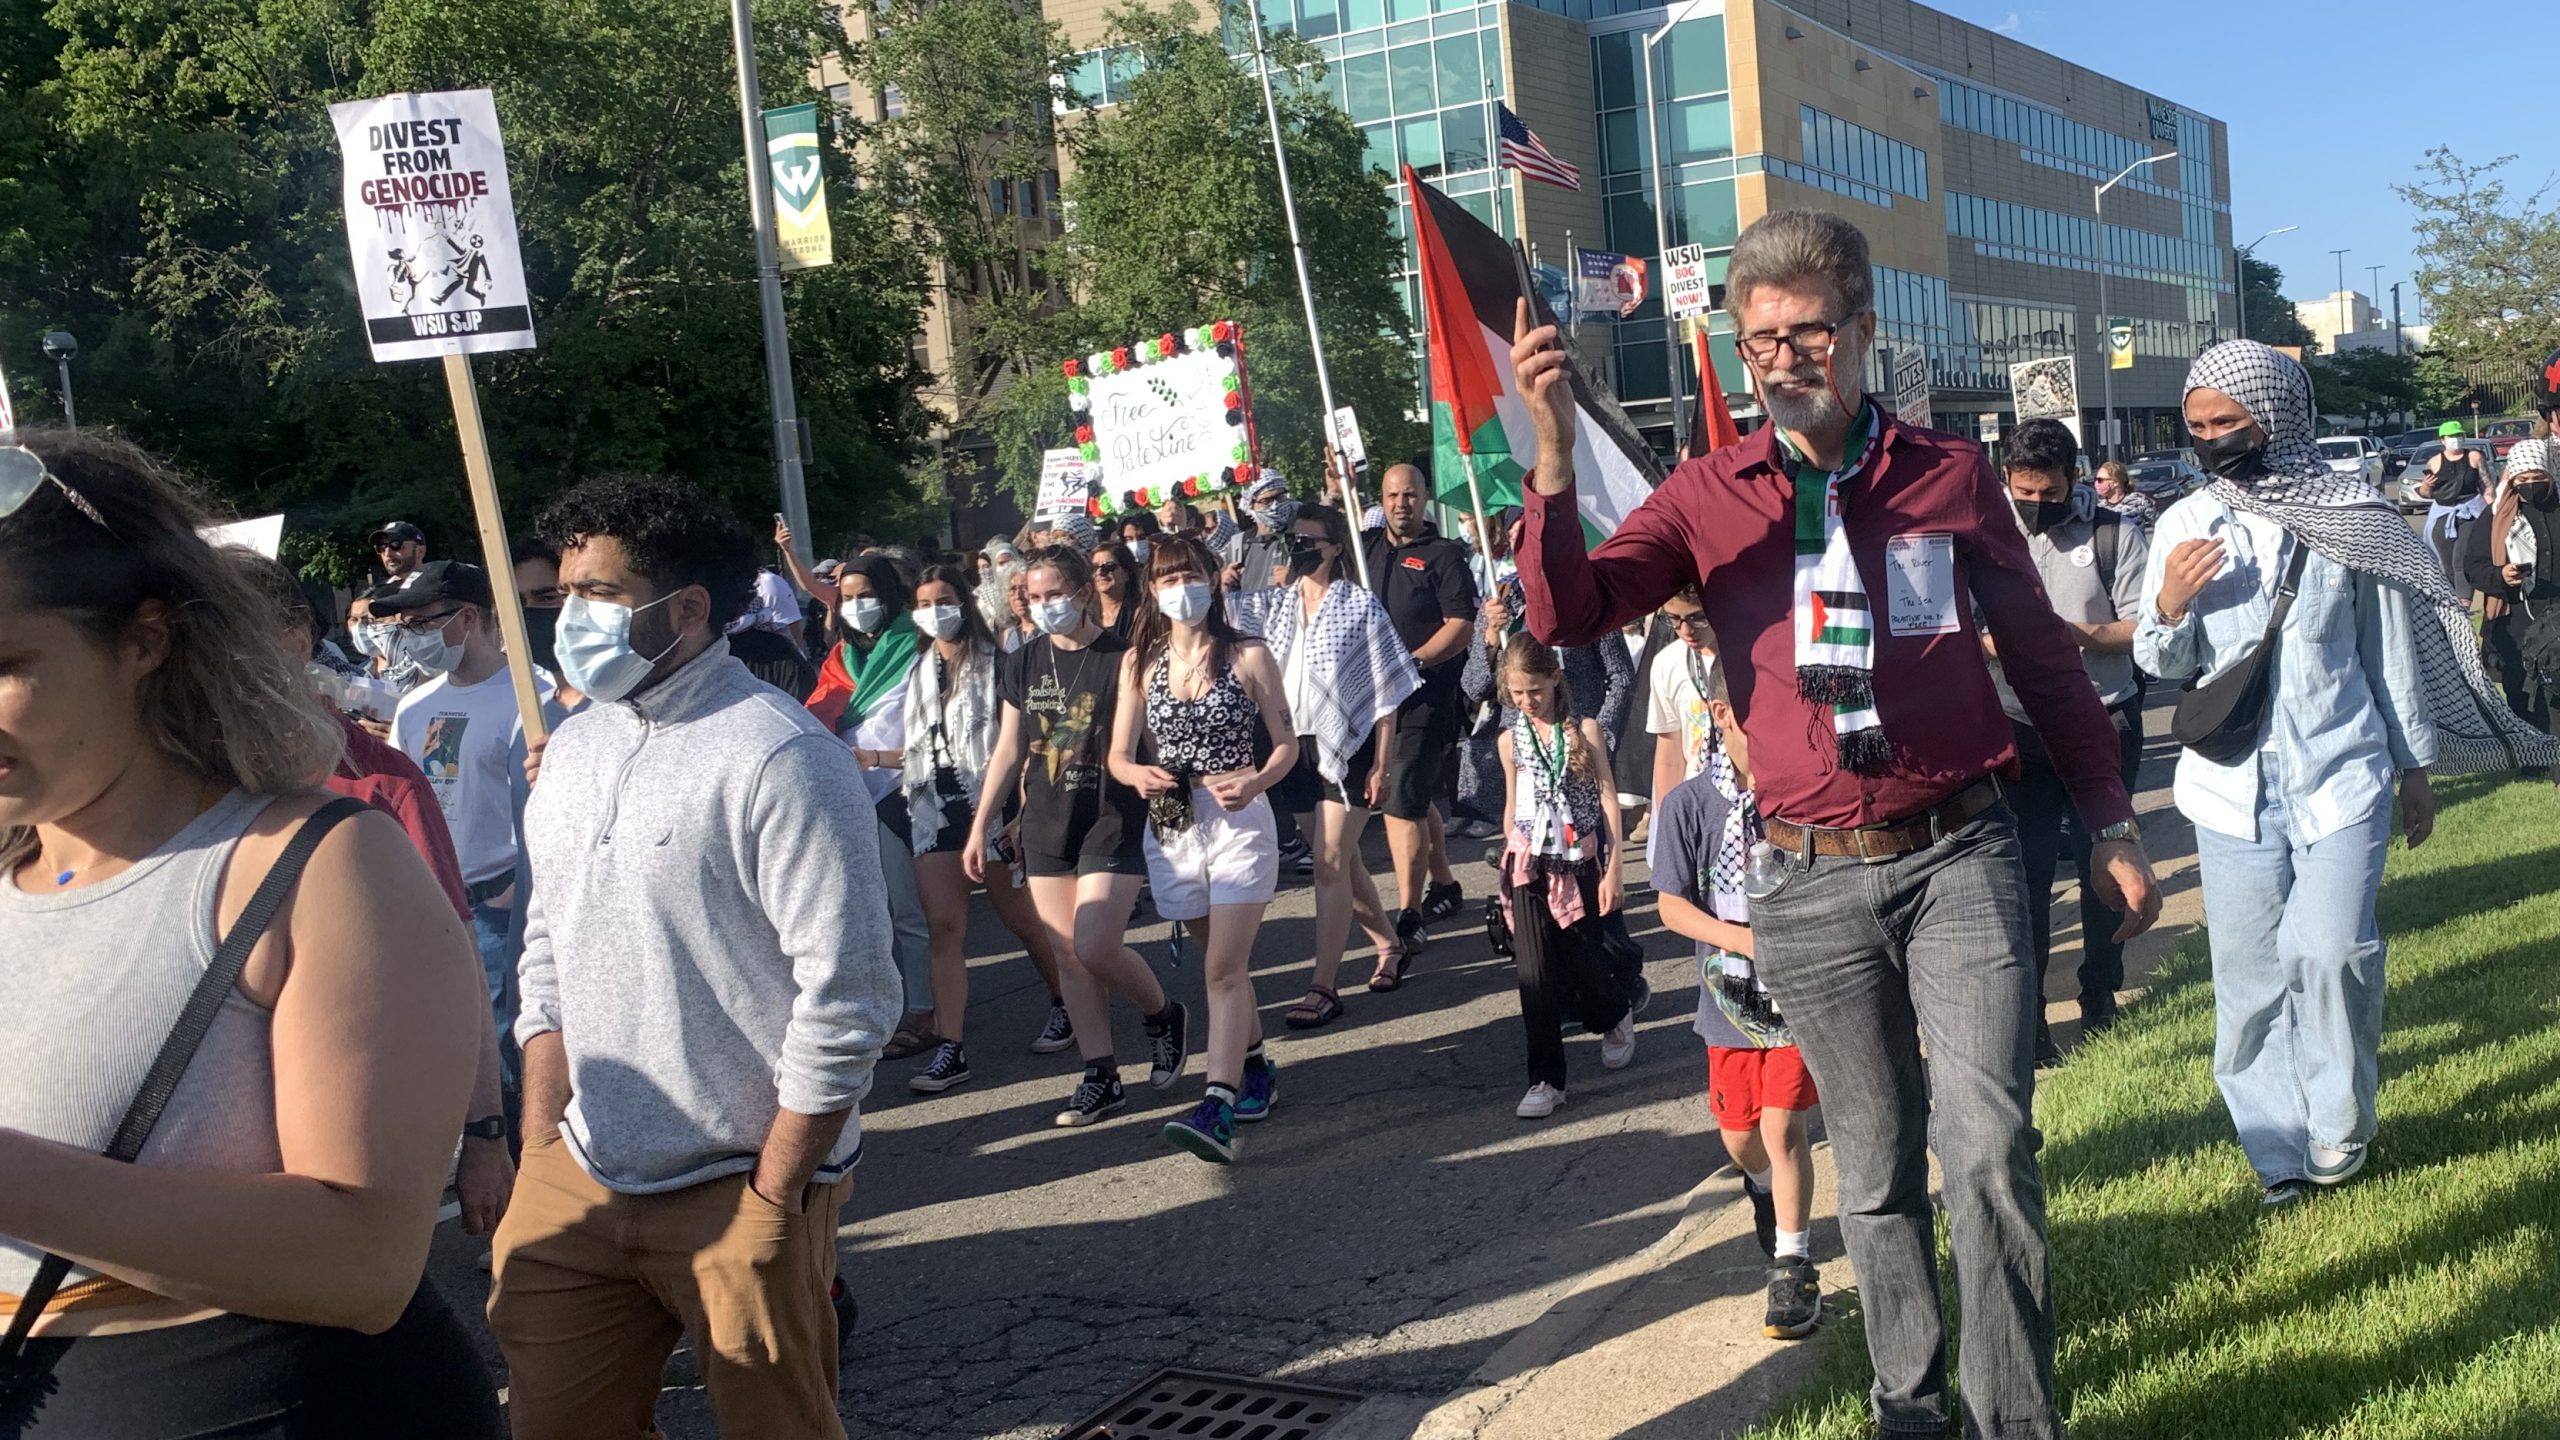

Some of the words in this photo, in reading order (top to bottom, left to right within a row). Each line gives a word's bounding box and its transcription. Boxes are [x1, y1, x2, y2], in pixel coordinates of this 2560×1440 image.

[369, 118, 462, 152] DIVEST
[382, 148, 453, 175] FROM
[361, 171, 489, 206] GENOCIDE
[784, 234, 826, 248] WARRIOR
[1665, 245, 1701, 267] WSU
[1675, 266, 1696, 280] BOG
[1670, 278, 1705, 294] DIVEST
[1676, 292, 1703, 306] NOW!
[411, 314, 448, 336] WSU
[450, 311, 482, 333] SJP
[1896, 361, 1924, 394] LIVES
[1926, 369, 1981, 389] WELCOME
[1898, 384, 1927, 411] MATTER
[1102, 392, 1157, 431] Free
[1113, 416, 1197, 477] Palestine
[1028, 685, 1067, 698] Smashing
